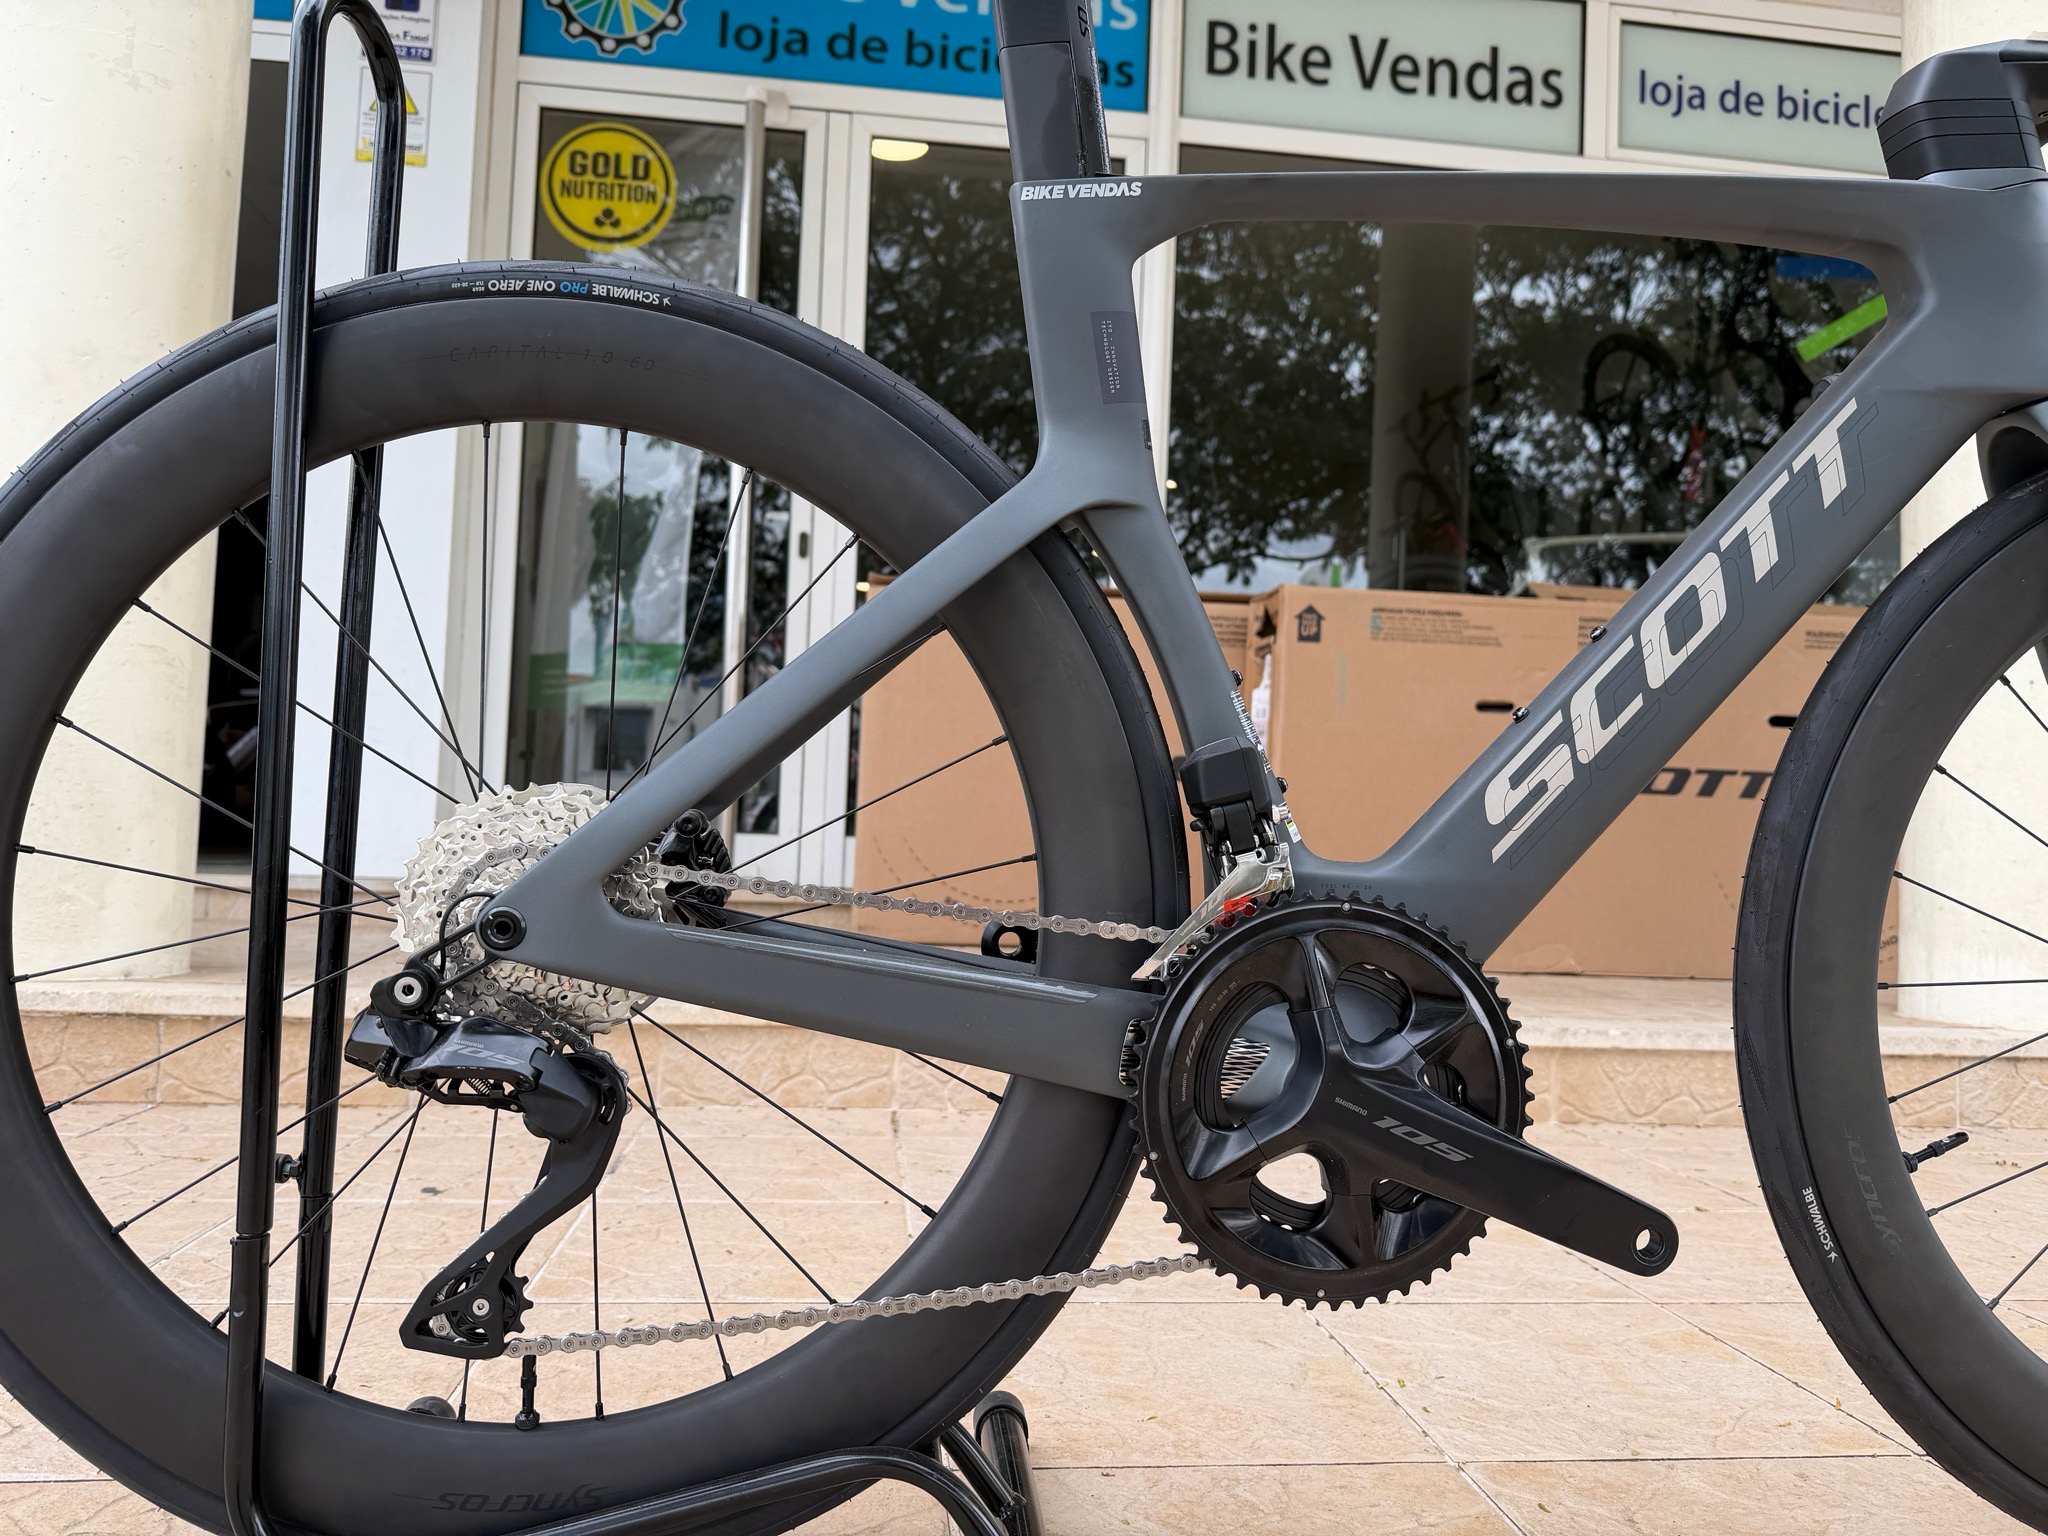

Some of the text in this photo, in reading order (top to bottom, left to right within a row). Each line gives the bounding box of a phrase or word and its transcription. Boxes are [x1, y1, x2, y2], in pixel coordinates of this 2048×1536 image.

[718, 10, 809, 62] loja
[826, 22, 888, 65] de
[1205, 19, 1564, 110] Bike Vendas
[1638, 68, 1706, 118] loja
[1718, 79, 1765, 117] de
[569, 150, 650, 181] GOLD
[560, 179, 657, 204] NUTRITION
[1021, 181, 1142, 201] BIKE VENDAS
[488, 279, 661, 305] SCHWALBE PRO ONE AERO
[450, 345, 655, 371] CAPITAL 1.0 60
[1101, 321, 1115, 394] TECHNOLOGY DESIGN
[1484, 396, 1858, 866] SCOTT
[1641, 767, 1774, 799] OTT
[443, 1043, 525, 1066] 105
[454, 1038, 485, 1049] SHIMANO
[1185, 1019, 1204, 1068] 105
[1334, 1096, 1368, 1116] SHIMANO
[1372, 1115, 1474, 1162] 105
[1802, 1186, 1834, 1251] SCHWALBE
